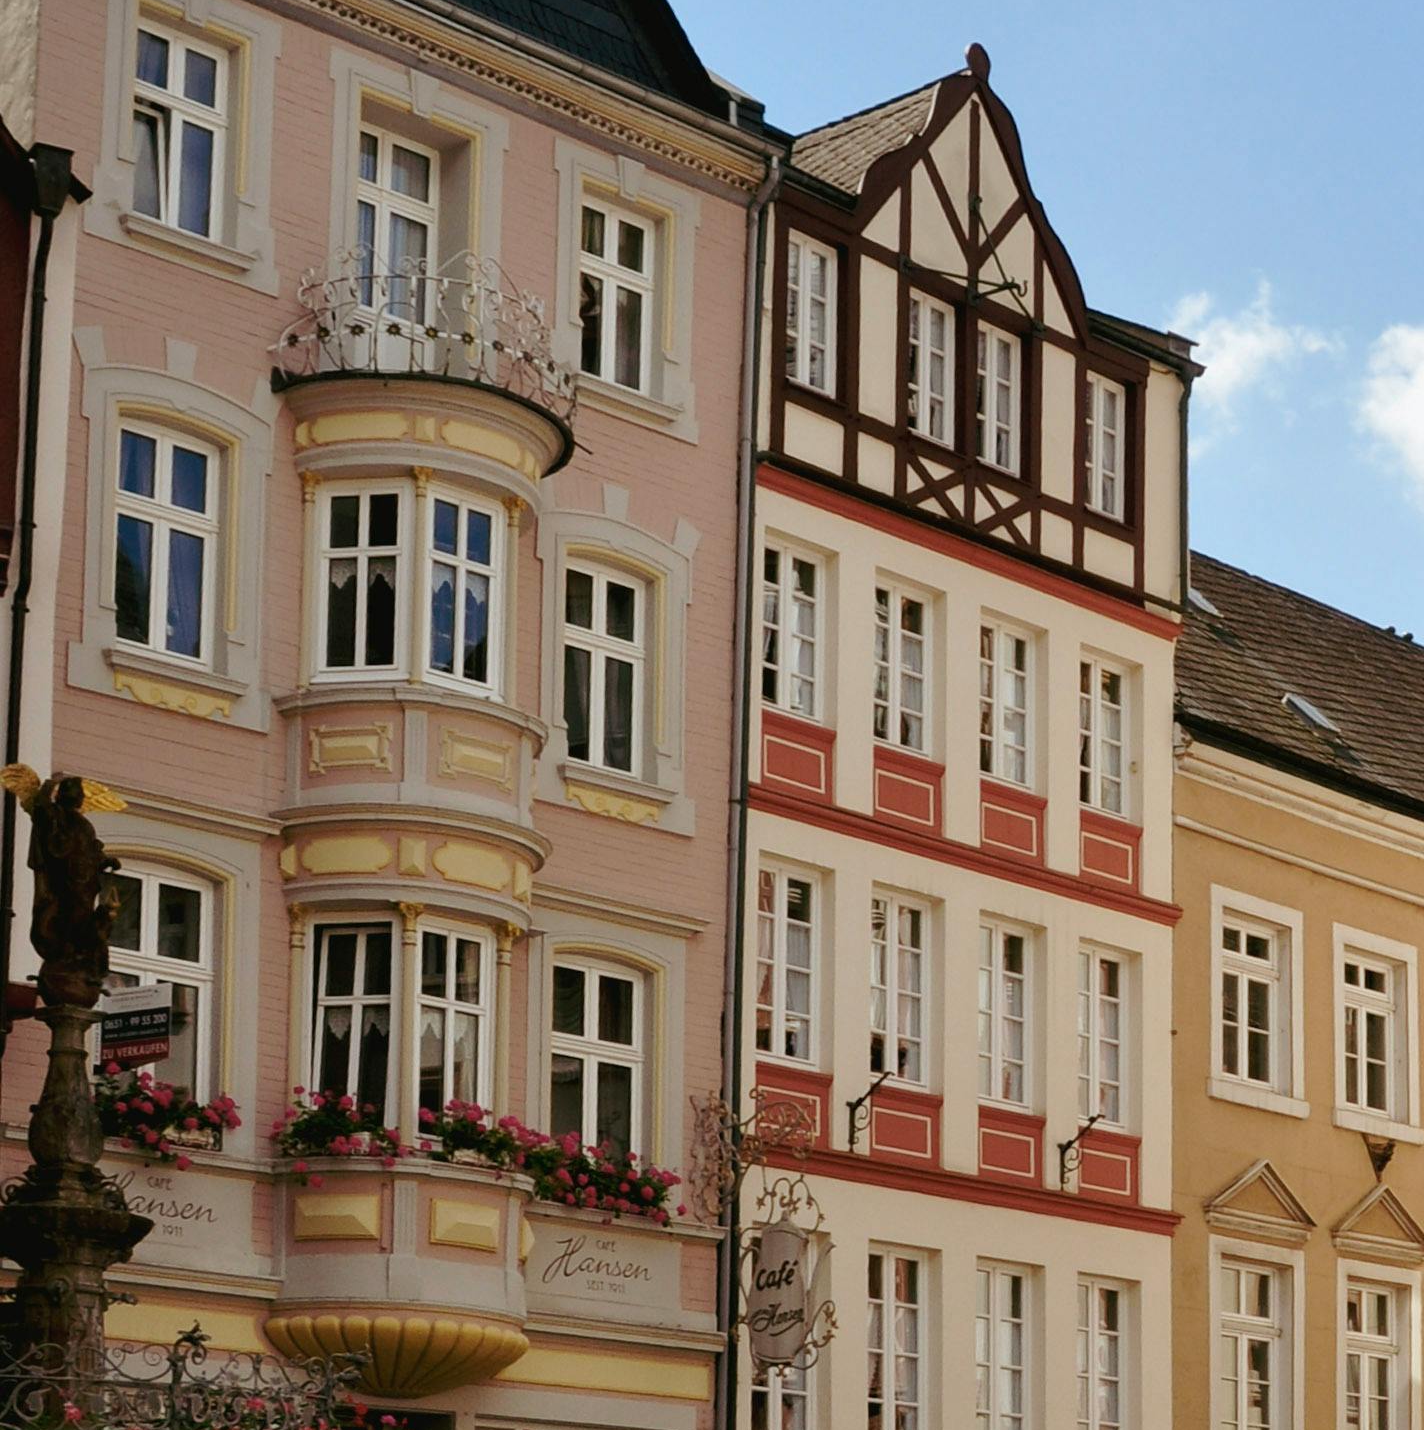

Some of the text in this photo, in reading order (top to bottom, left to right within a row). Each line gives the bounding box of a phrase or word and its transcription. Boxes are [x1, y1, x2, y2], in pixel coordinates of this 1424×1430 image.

[102, 1041, 169, 1060] ZU VERKAUFEN
[542, 1234, 653, 1284] Hansen
